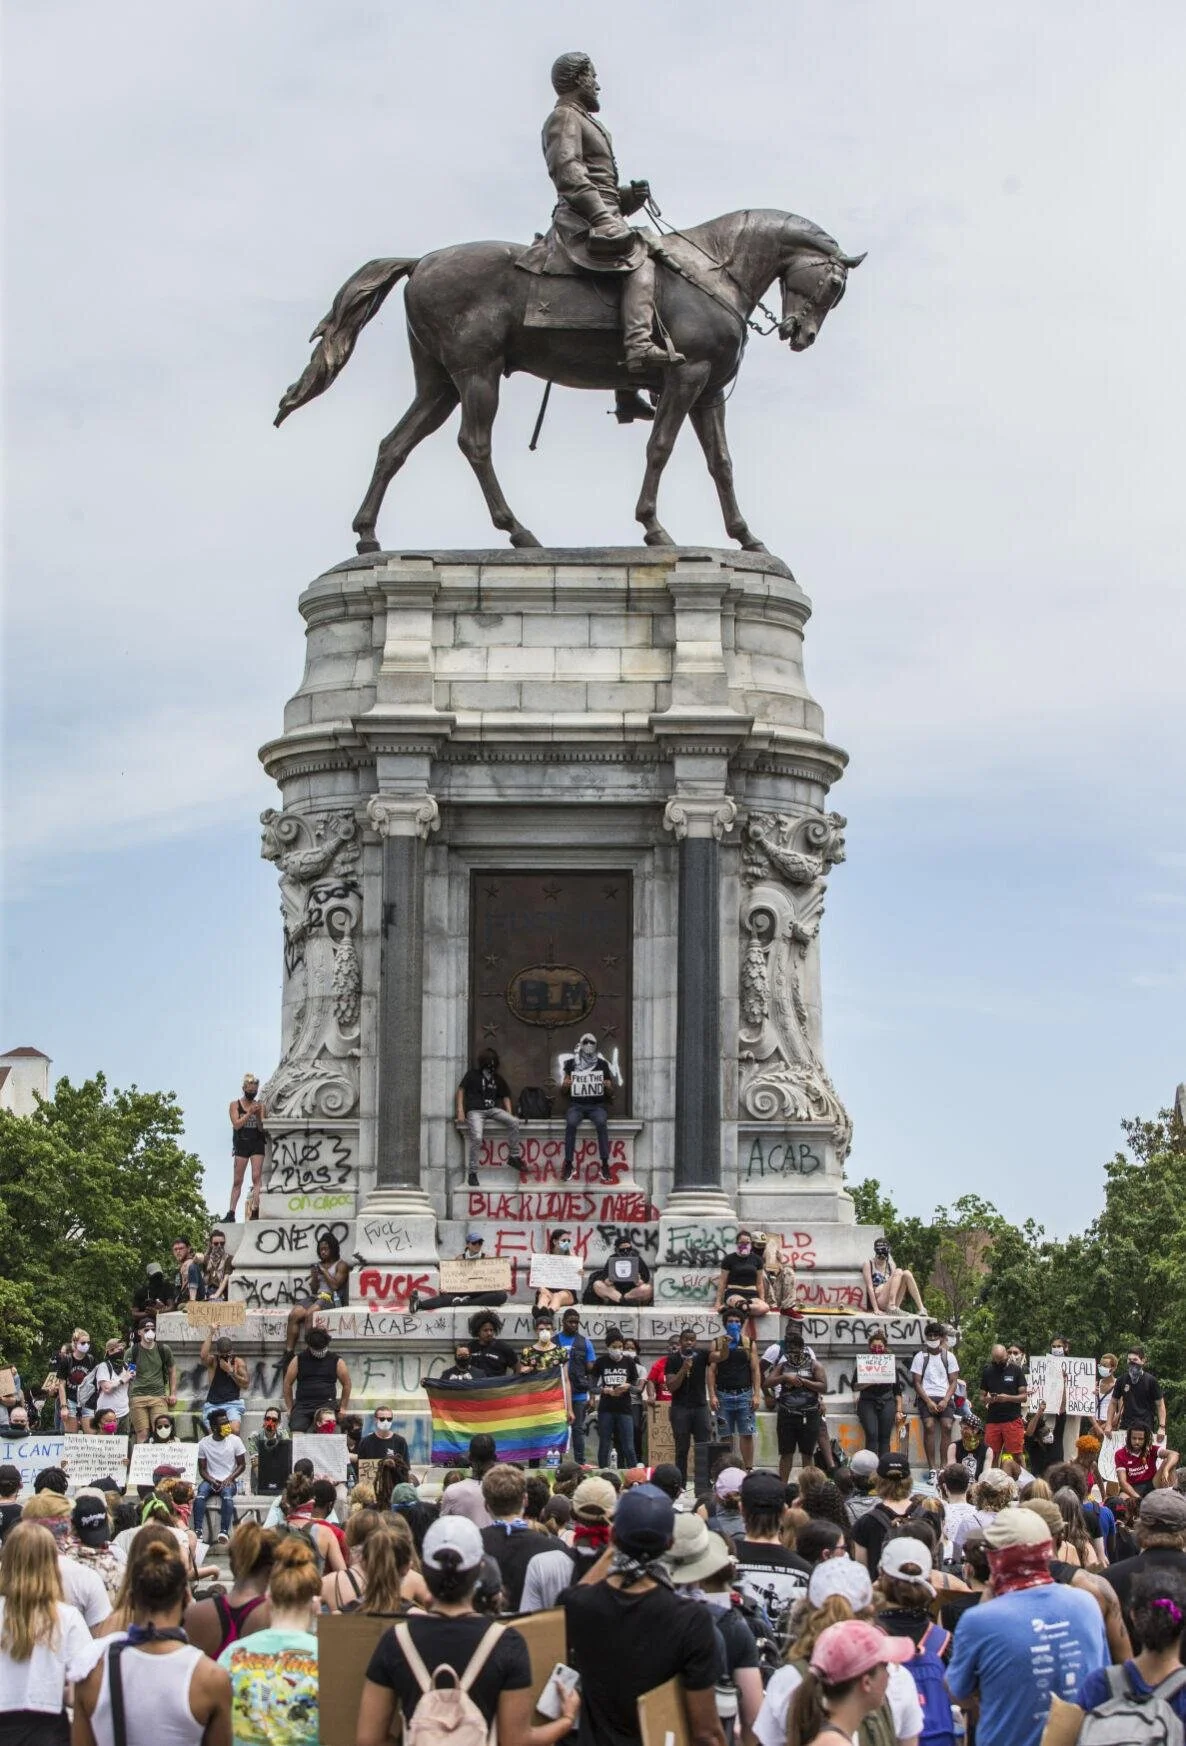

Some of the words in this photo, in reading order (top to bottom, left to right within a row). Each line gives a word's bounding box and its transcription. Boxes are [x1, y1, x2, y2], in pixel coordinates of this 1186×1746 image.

[573, 1075, 587, 1083] FREE
[589, 1074, 604, 1083] THE
[573, 1083, 604, 1095] LAND
[573, 1138, 626, 1163] YOR
[746, 1138, 821, 1178] ACAB
[468, 1191, 533, 1222] BLACK
[256, 1224, 315, 1254] ONE
[364, 1220, 402, 1245] FUCK
[495, 1226, 593, 1263] FUK
[597, 1224, 659, 1252] FUCK
[781, 1232, 812, 1248] LD
[781, 1252, 816, 1268] OPS
[246, 1278, 310, 1307] ACAB
[360, 1272, 438, 1300] FUCK
[363, 1313, 417, 1336] ACAB
[579, 1319, 633, 1336] MORE
[652, 1320, 721, 1336] BLOOD
[801, 1318, 828, 1338] ND
[835, 1320, 925, 1343] RACISM
[361, 1356, 446, 1394] FUC
[605, 1376, 625, 1384] LIVES
[1031, 1362, 1046, 1374] WH
[1074, 1361, 1096, 1376] CALL
[1032, 1375, 1046, 1386] WH
[1066, 1374, 1079, 1387] HE
[1068, 1386, 1091, 1401] RER
[1069, 1402, 1096, 1413] BADGE
[3, 1443, 14, 1459] I
